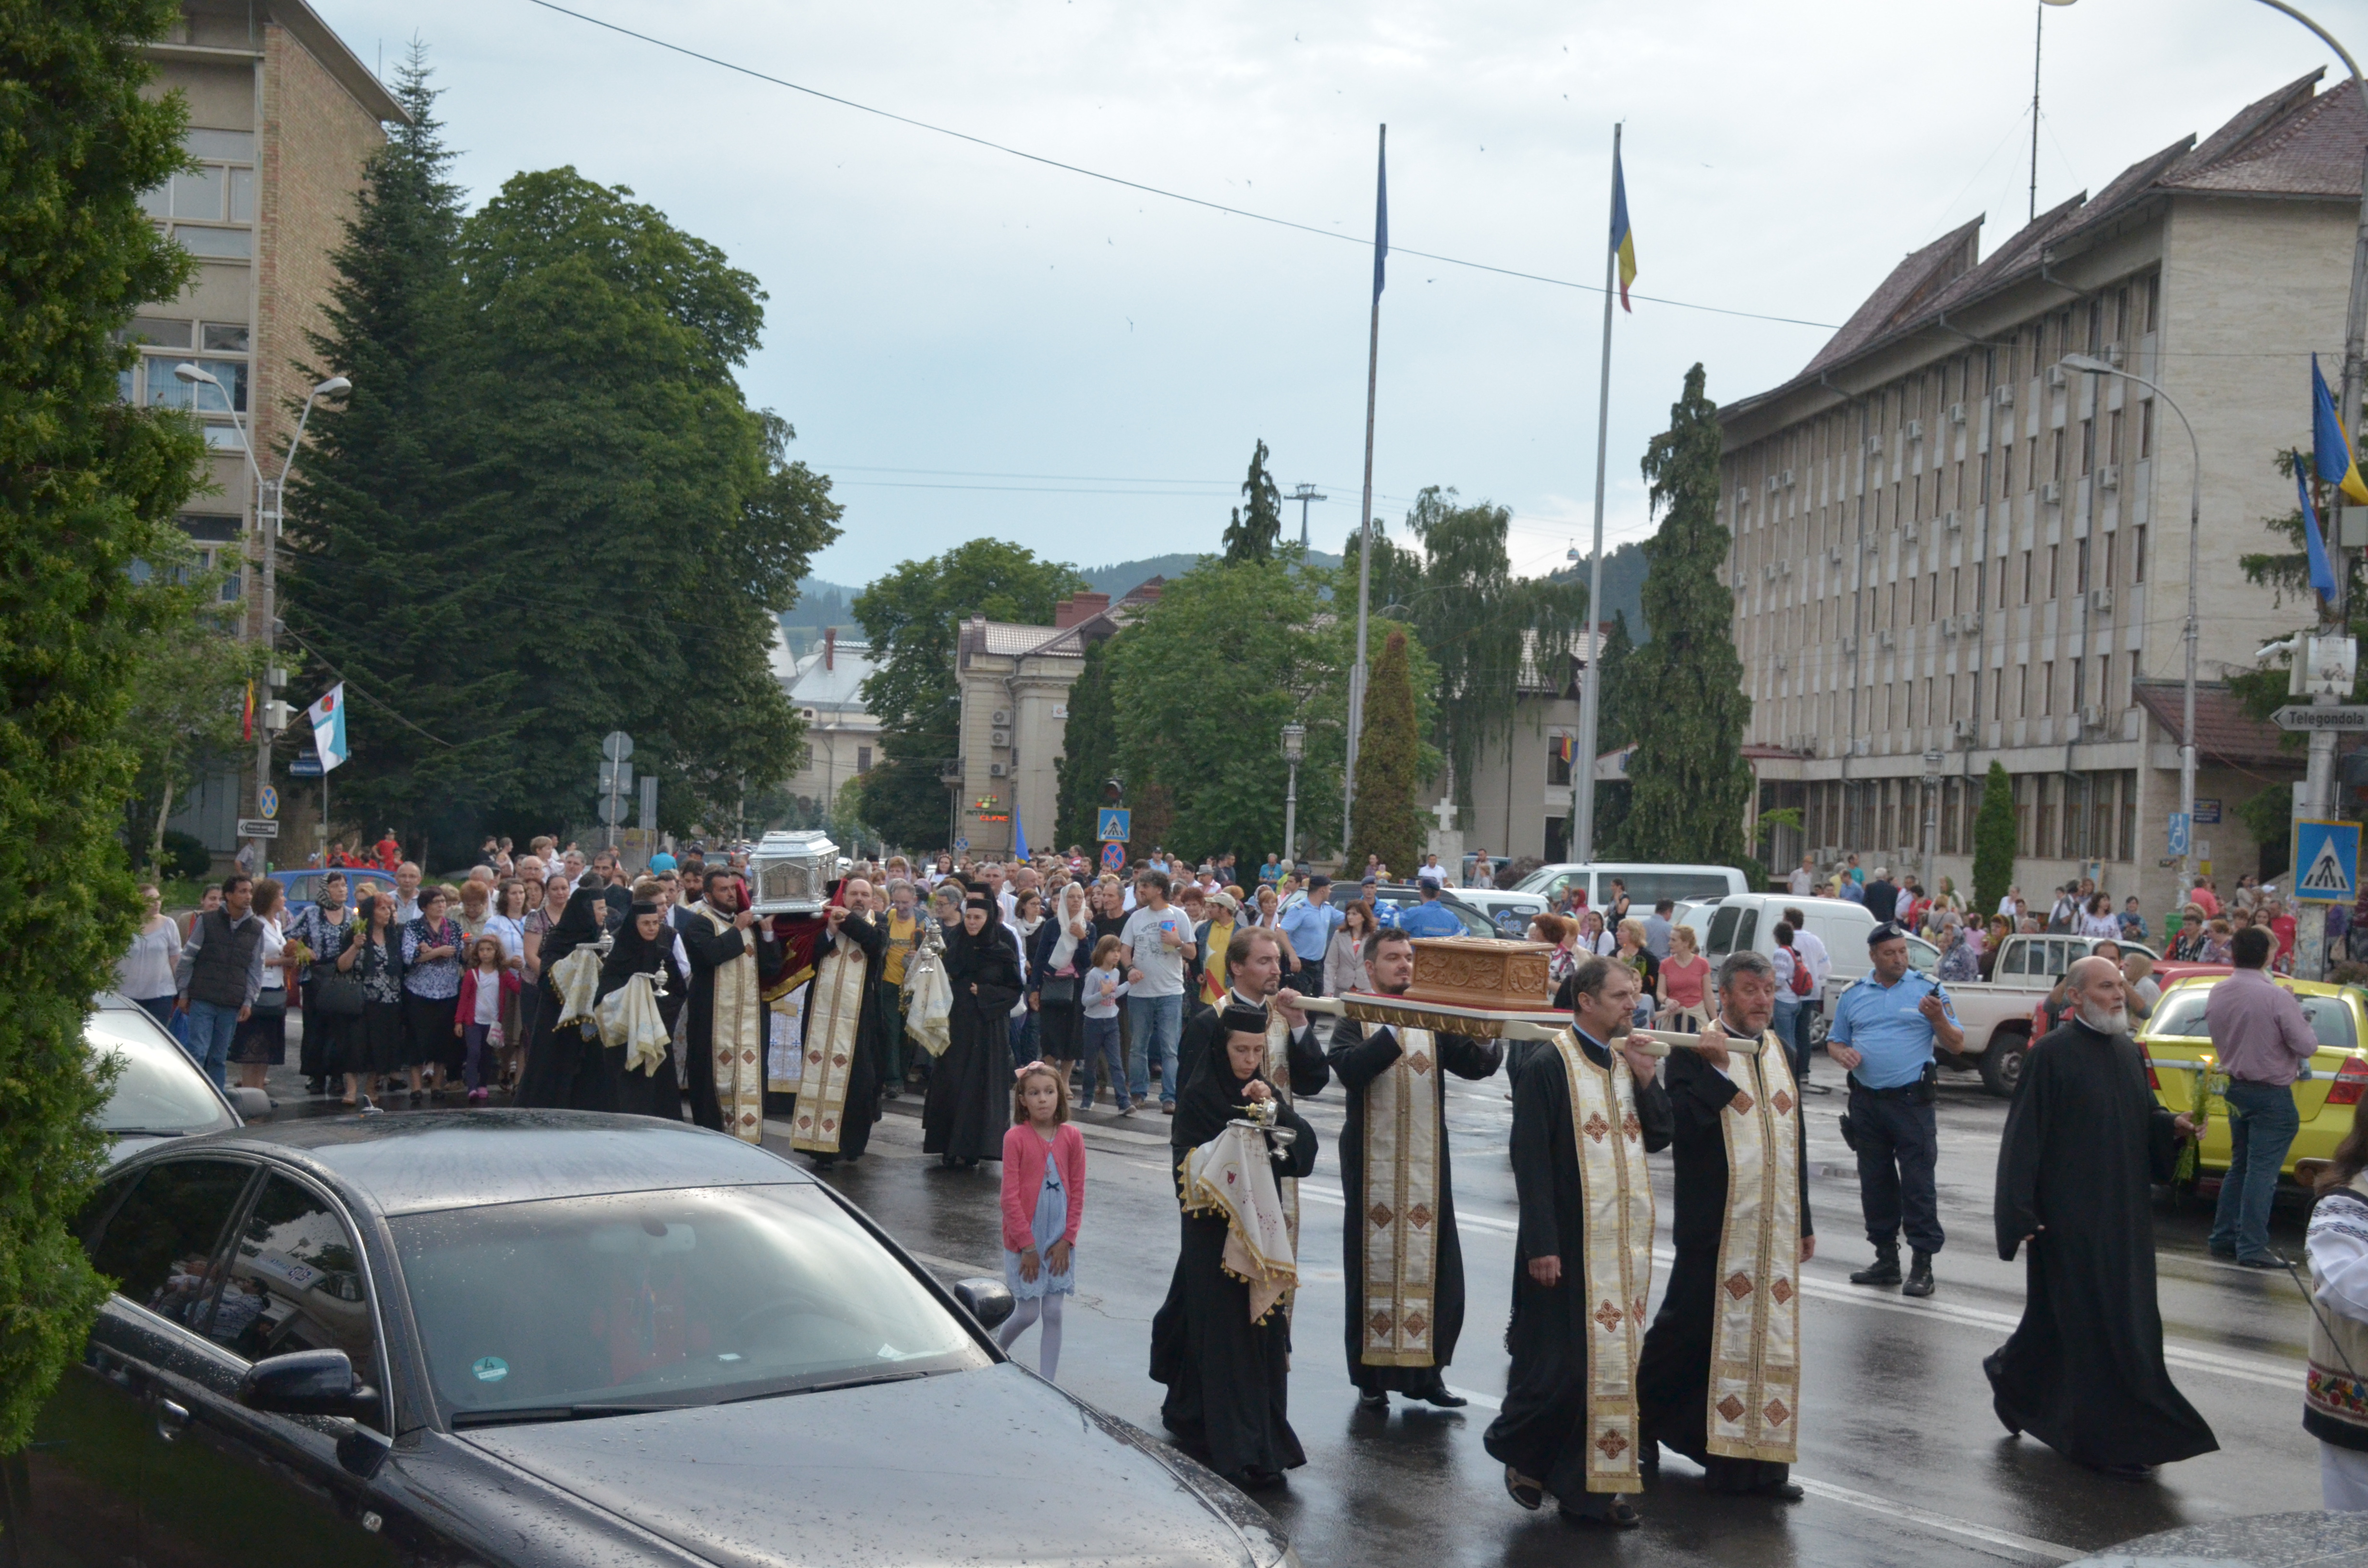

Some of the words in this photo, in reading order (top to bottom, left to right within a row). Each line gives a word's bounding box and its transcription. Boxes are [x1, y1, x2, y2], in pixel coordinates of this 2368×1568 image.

[2289, 711, 2364, 727] Telegondola
[1141, 922, 1157, 932] SPEED
[1504, 920, 1521, 931] 112
[484, 1358, 495, 1369] 4
